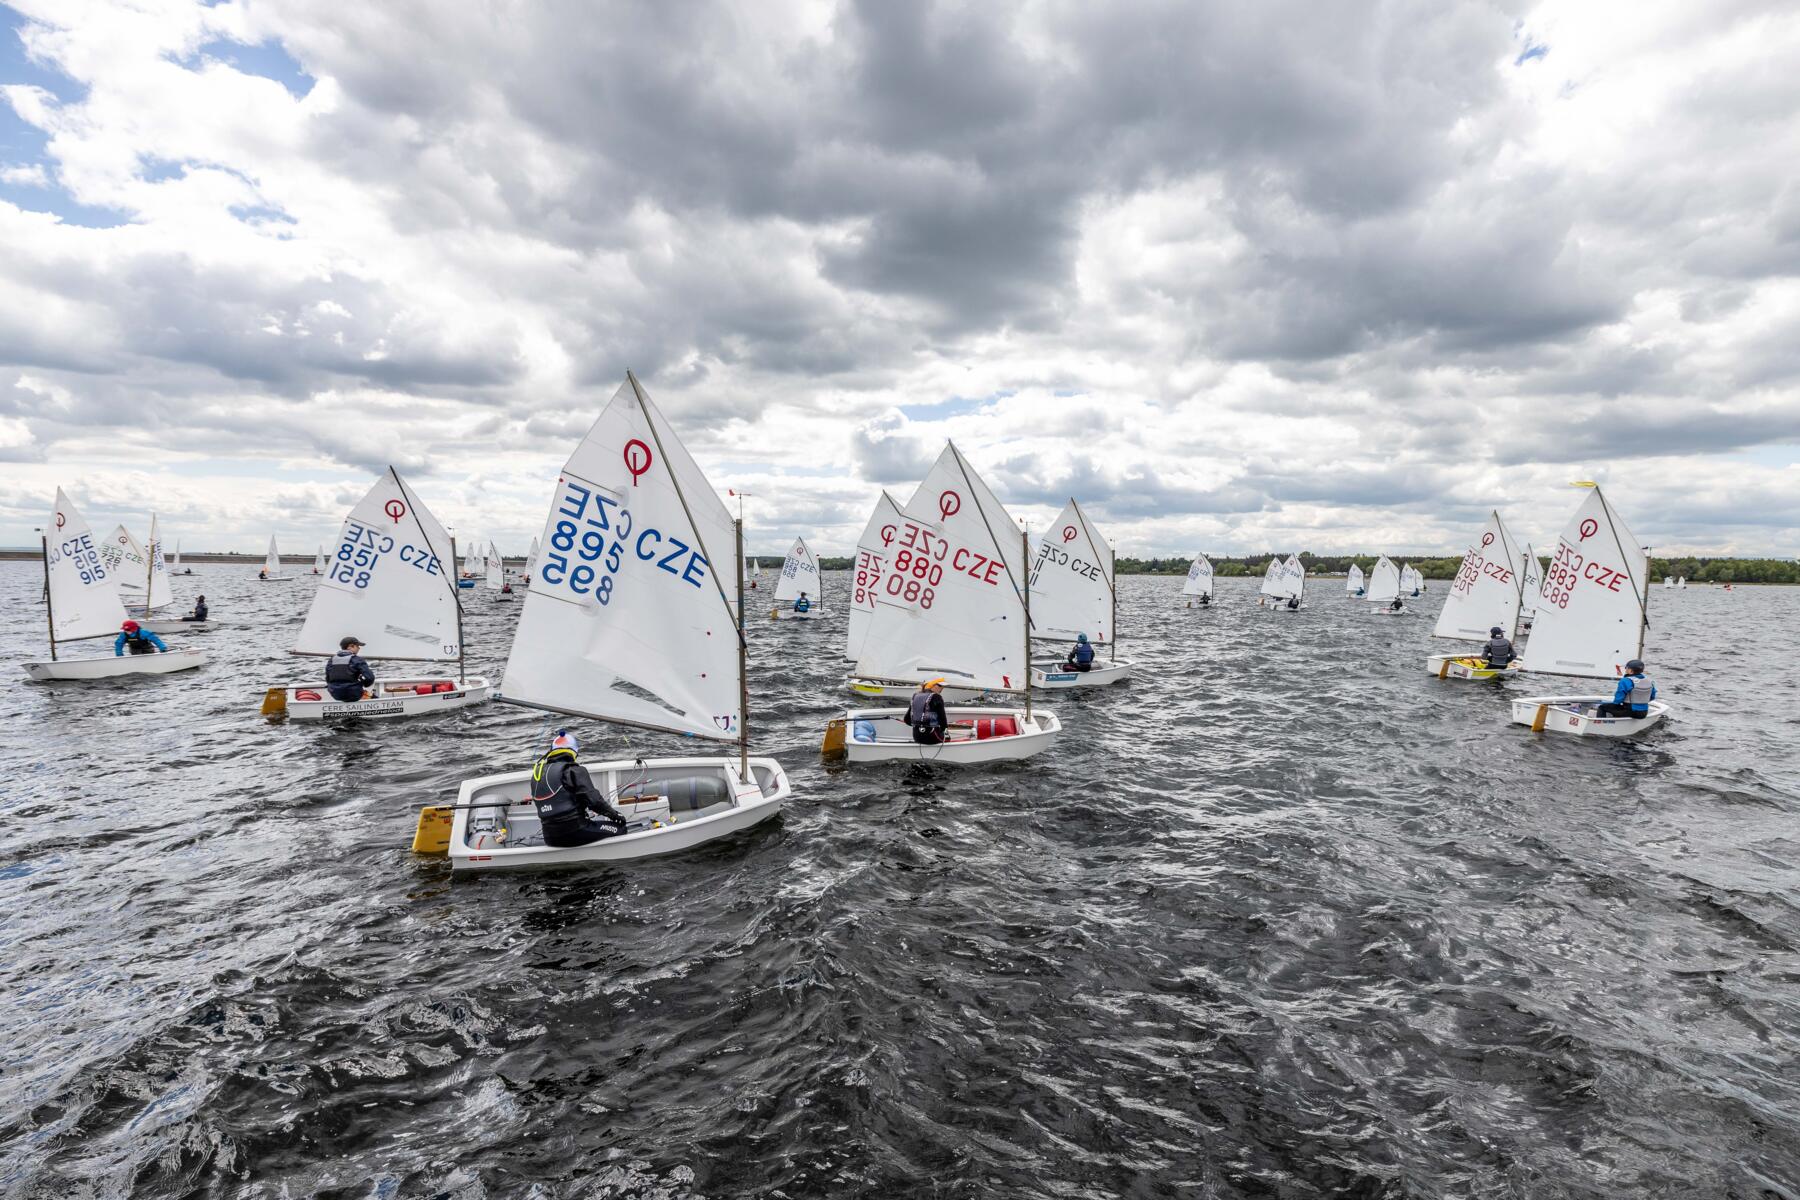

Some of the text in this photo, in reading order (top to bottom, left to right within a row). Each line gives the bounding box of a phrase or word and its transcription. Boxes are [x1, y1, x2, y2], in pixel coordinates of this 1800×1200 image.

[62, 534, 94, 557] CZE
[337, 543, 379, 571] 851
[551, 520, 624, 574] 895
[125, 552, 144, 565] CZE
[400, 544, 441, 576] CZE
[636, 528, 709, 588] CZE
[800, 562, 816, 573] CZE
[895, 550, 943, 587] 880
[952, 548, 1004, 586] CZE
[1071, 558, 1102, 582] CZE
[79, 564, 106, 585] 915
[1459, 563, 1479, 582] 703
[1483, 562, 1514, 584] CZE
[1549, 563, 1577, 591] 883
[1584, 562, 1629, 592] CZE
[346, 702, 379, 711] SAILING
[382, 700, 404, 709] TEAM
[600, 824, 618, 834] MUSTO
